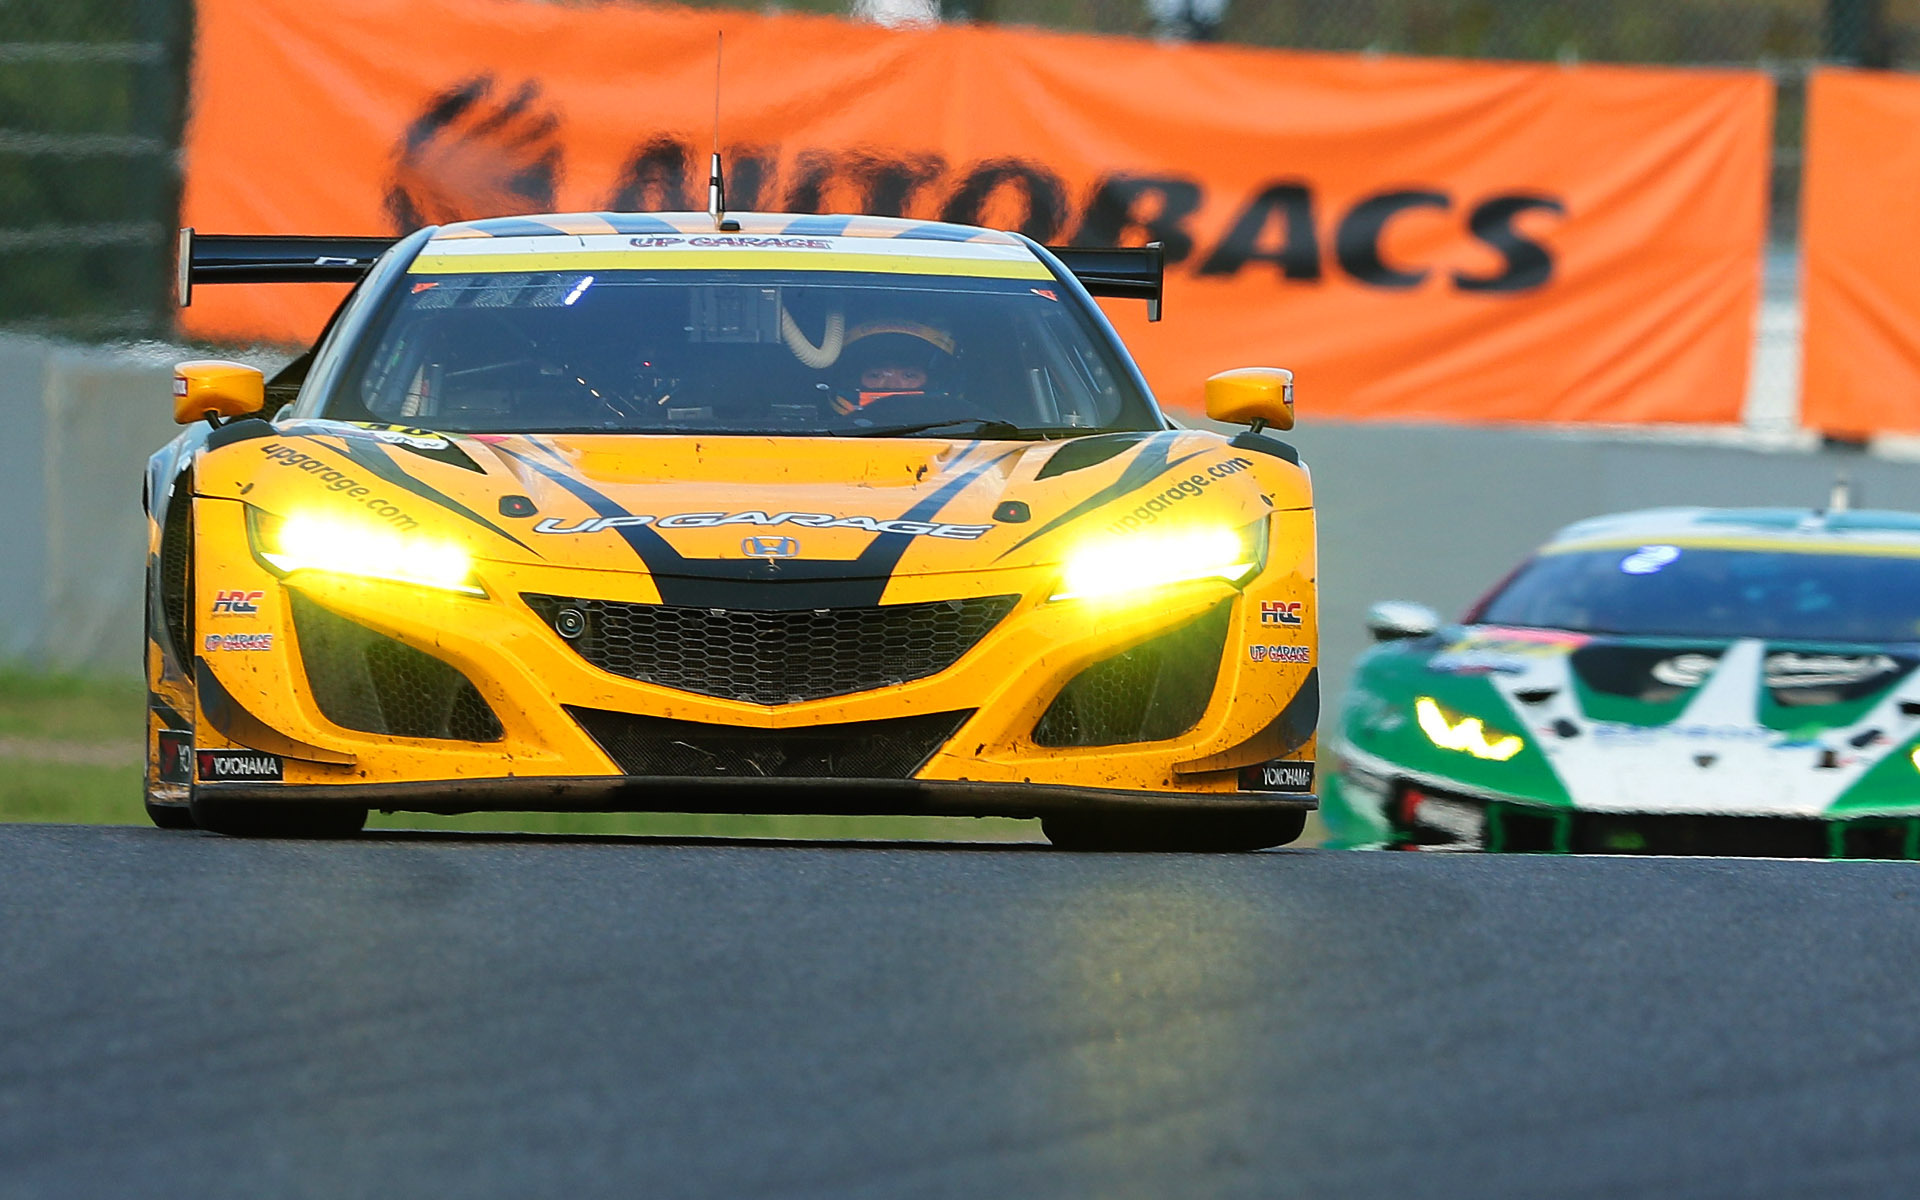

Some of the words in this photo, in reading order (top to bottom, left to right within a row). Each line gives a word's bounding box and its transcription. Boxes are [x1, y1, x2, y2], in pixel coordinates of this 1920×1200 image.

[608, 137, 1566, 294] AUTOBACS
[629, 237, 685, 248] UP
[687, 236, 833, 250] GARAGE
[261, 443, 419, 532] upgarage.com
[1106, 456, 1253, 536] upgarage.com
[534, 515, 658, 534] UP
[656, 511, 994, 540] GARAGE
[212, 591, 264, 613] HRC
[1261, 601, 1301, 625] HRC
[1249, 645, 1267, 662] UP
[1268, 645, 1310, 664] GARAGE
[213, 757, 279, 775] YOKOHAMA
